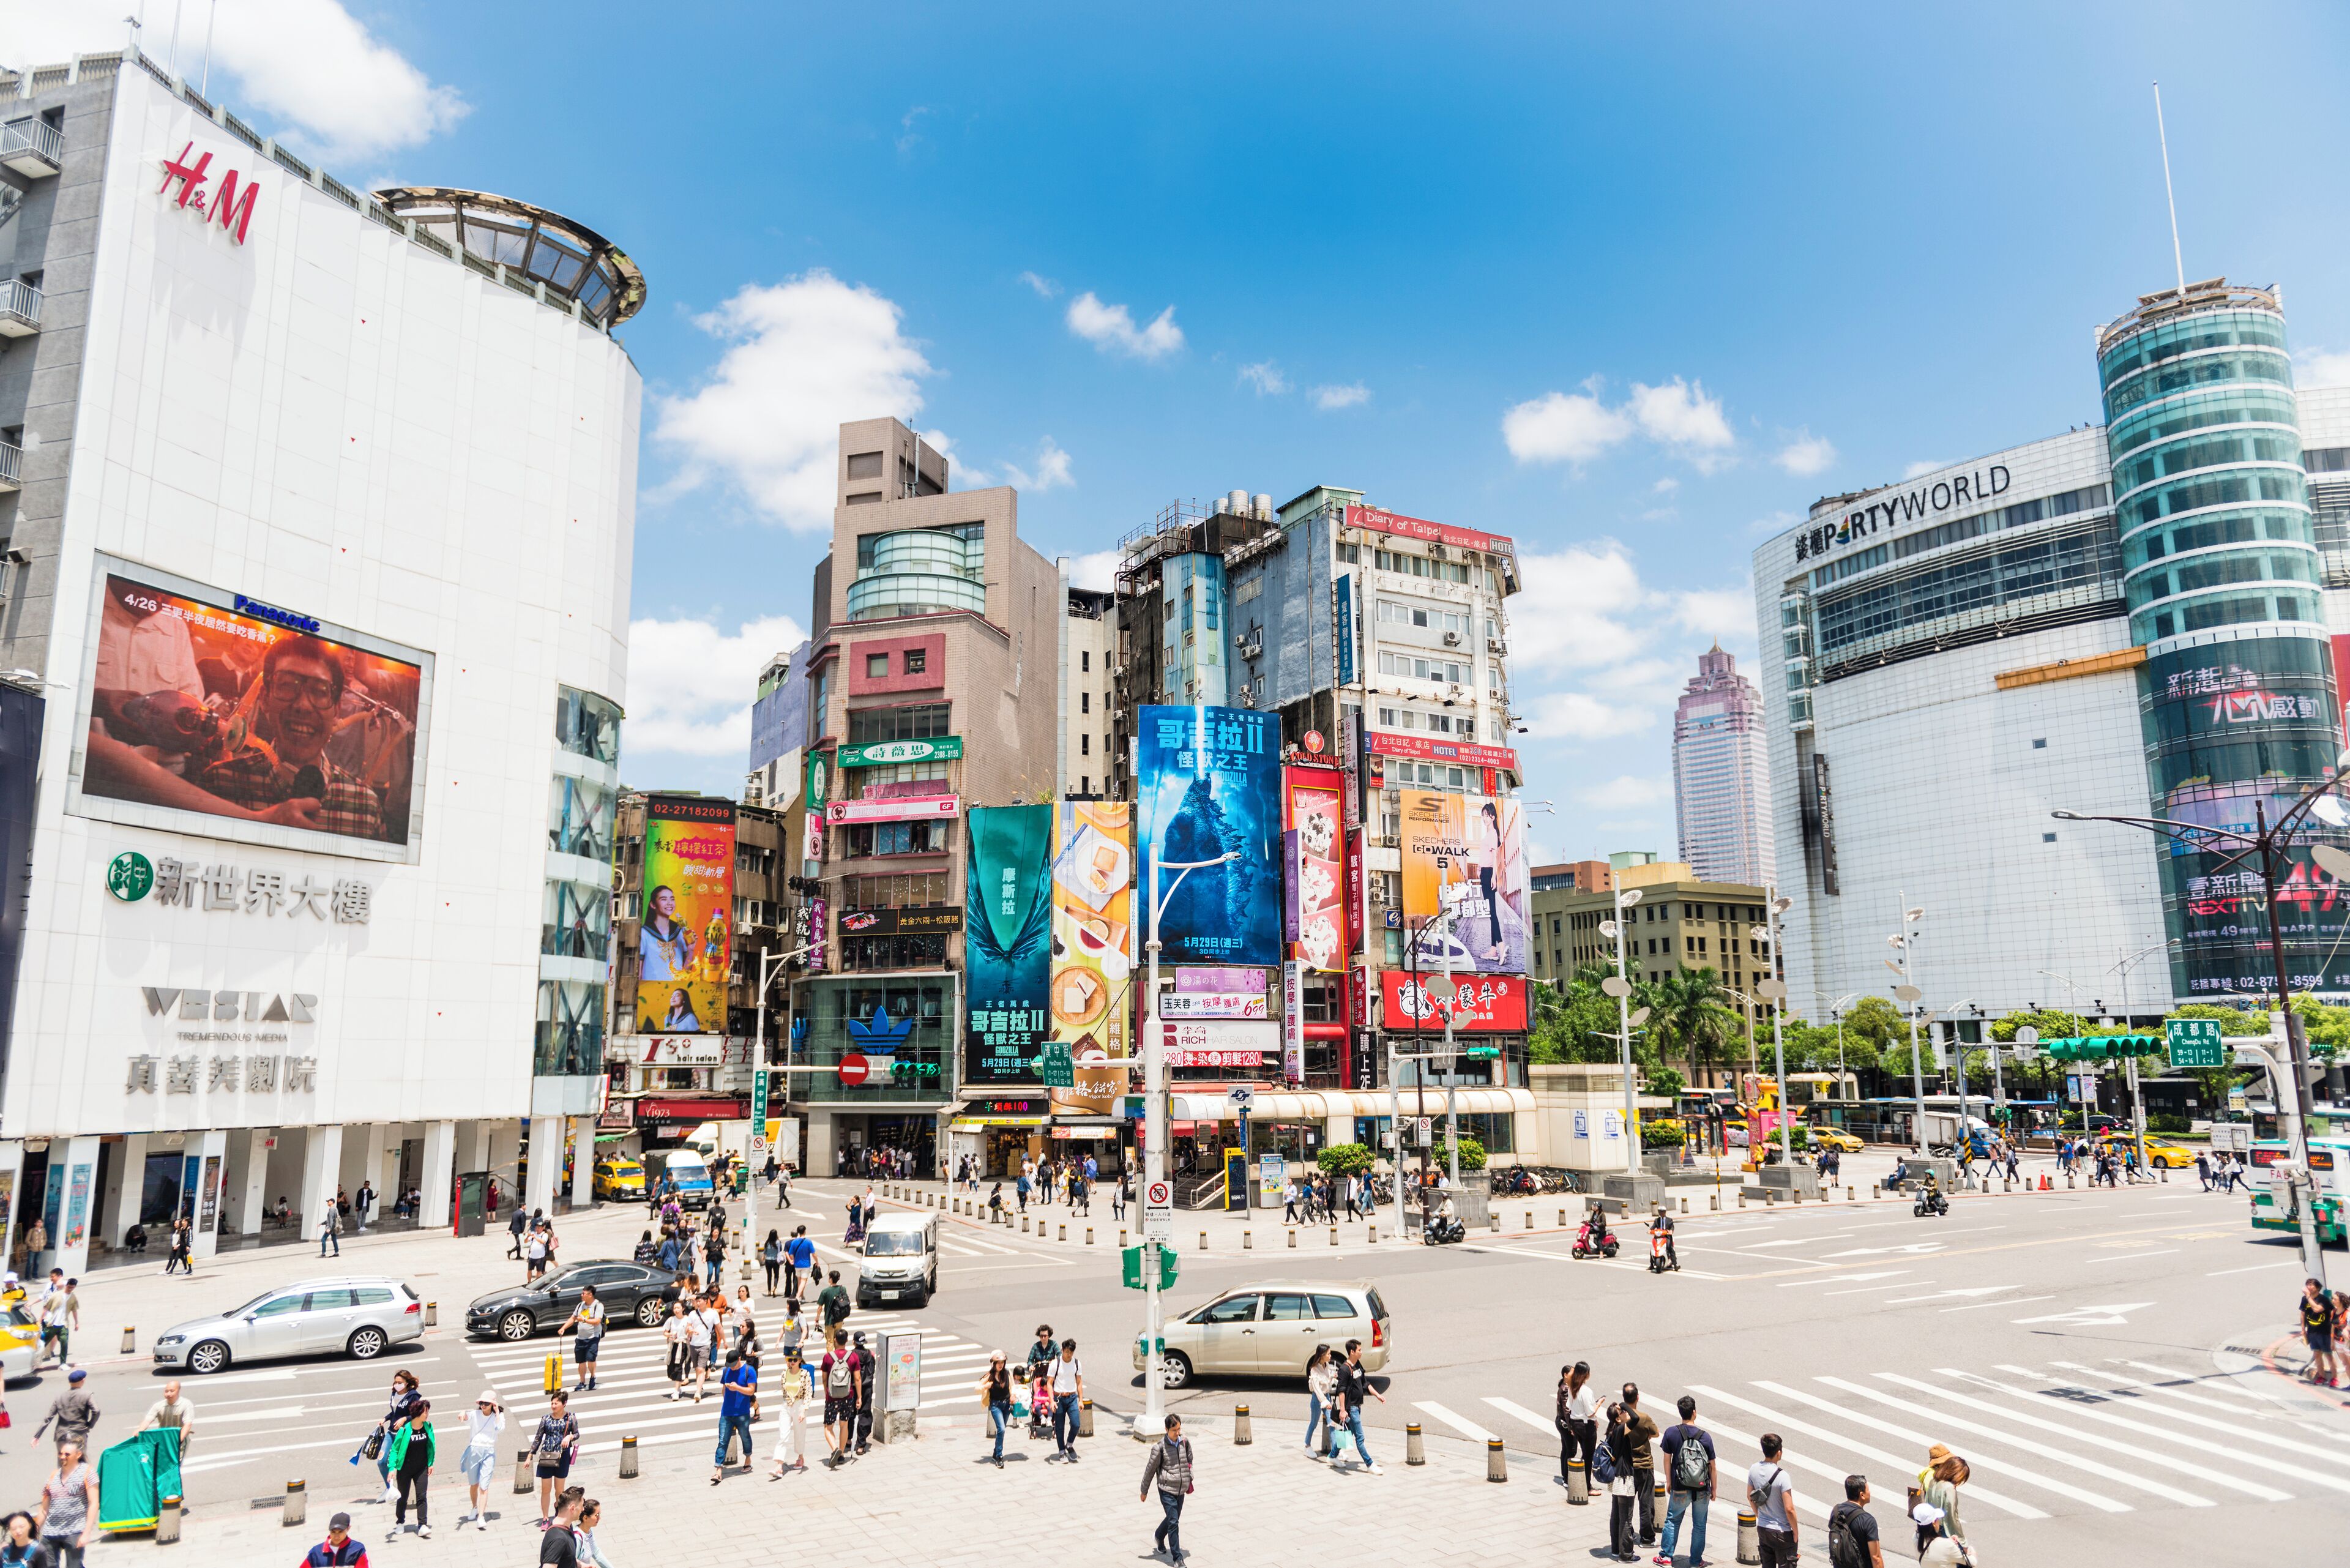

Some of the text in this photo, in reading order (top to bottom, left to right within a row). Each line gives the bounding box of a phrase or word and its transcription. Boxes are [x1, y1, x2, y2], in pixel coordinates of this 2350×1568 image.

[163, 140, 260, 246] H&M
[1366, 512, 1441, 537] Diary of Taipei
[124, 593, 277, 646] 4/26 三更半夜居然要吃香蕉？
[234, 594, 321, 633] Panasonic
[1207, 711, 1263, 724] 唯一王者制霸
[1157, 719, 1264, 754] 哥吉拉II
[873, 745, 924, 758] 詩薇思
[934, 750, 958, 759] 2388-8155
[1433, 745, 1457, 756] HOTEL
[1313, 753, 1340, 768] STONE
[1460, 756, 1499, 764] (02)2314-4003
[654, 804, 729, 817] 02-27182099
[1408, 811, 1450, 819] SKECHERS
[1412, 835, 1461, 845] SKECHERS
[676, 842, 725, 856] 檸檬紅茶
[1437, 857, 1448, 868] 5
[683, 864, 725, 878] 酸甜漸層
[154, 857, 373, 924] 新世界大樓
[1002, 867, 1016, 916] 摩斯拉
[2221, 925, 2238, 936] 49
[1185, 936, 1243, 949] 5月29日(週三)
[1193, 976, 1218, 986] 湯の花
[2240, 975, 2324, 988] 02-875-8599
[1287, 978, 1295, 1004] 按摩
[141, 987, 318, 1023] WESTAR
[1164, 998, 1191, 1009] 玉芙蓉
[1203, 996, 1222, 1009] 按摩
[1223, 997, 1240, 1009] 護膚
[971, 1010, 1044, 1032] 哥吉拉II
[1109, 991, 1121, 1050] 首選維格
[1287, 1014, 1296, 1040] 護膚
[2173, 1023, 2215, 1036] 成都路
[177, 1032, 288, 1043] TREMENDOUS MEDIA
[983, 1033, 1031, 1045] 怪獸之王
[1045, 1045, 1069, 1058] 漢中街
[125, 1053, 318, 1095] 真善美劇院
[756, 1078, 765, 1109] 漢中街
[1816, 1084, 1830, 1094] 5 5
